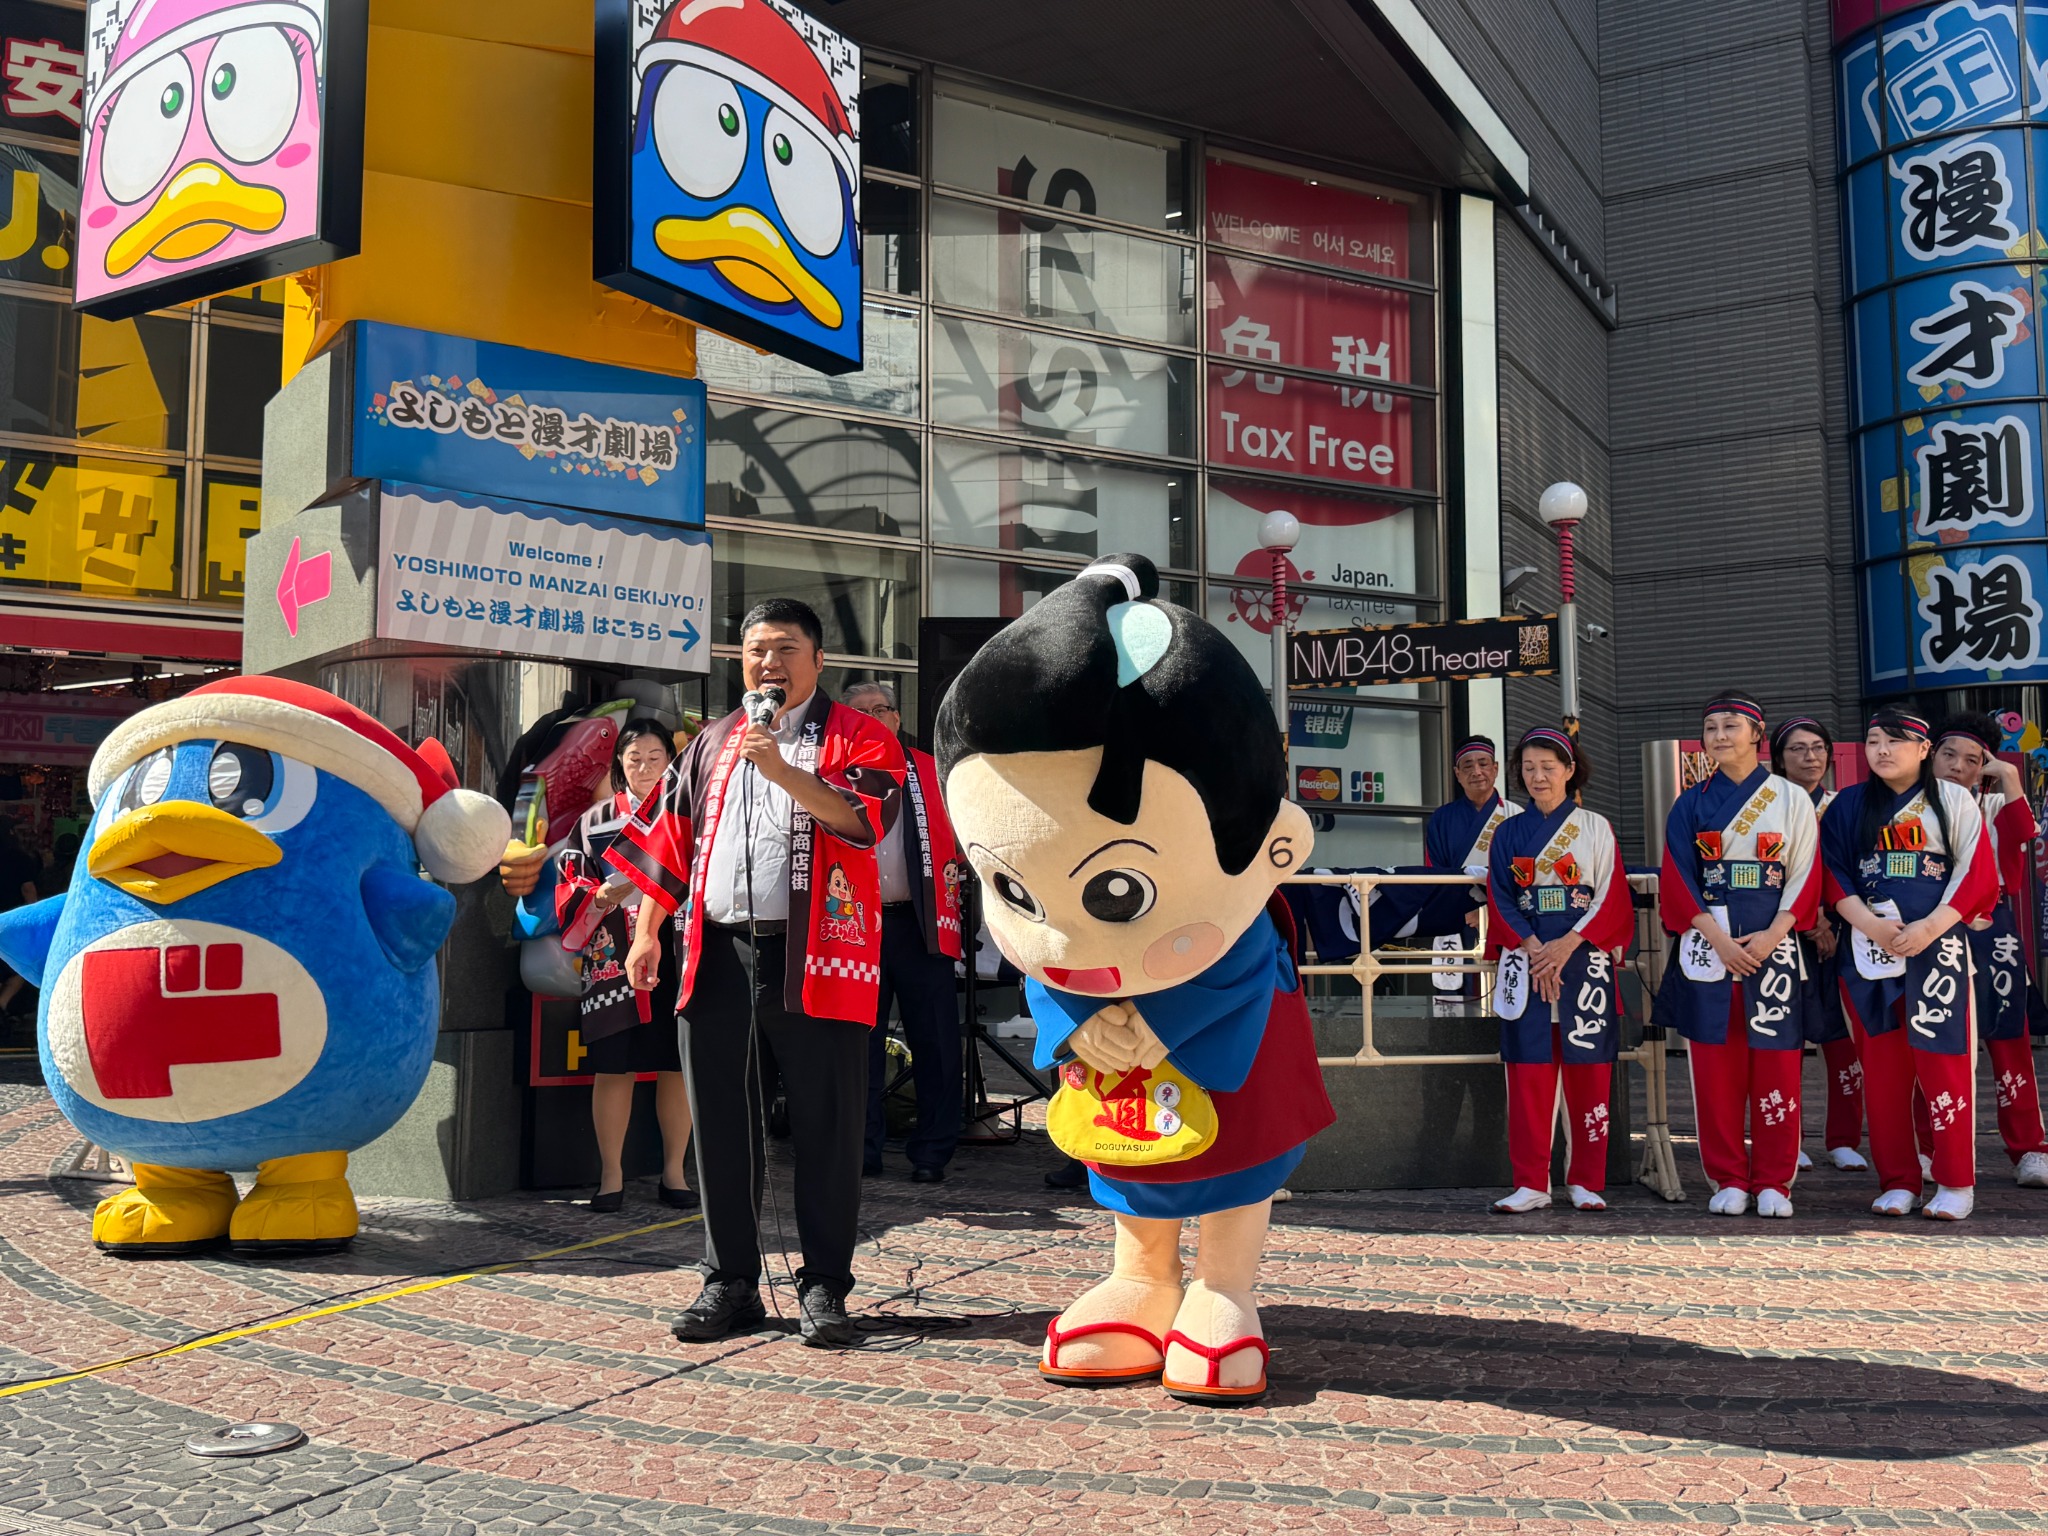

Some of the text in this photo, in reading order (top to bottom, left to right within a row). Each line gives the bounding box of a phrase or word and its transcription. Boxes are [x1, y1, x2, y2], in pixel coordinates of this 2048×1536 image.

[1899, 41, 1995, 132] 5F
[1211, 211, 1300, 245] WELCOME
[1312, 231, 1396, 265] 어서 오세요
[391, 390, 674, 466] よしもと漫才劇場
[1908, 150, 2034, 665] 漫才劇場
[1220, 411, 1395, 475] Tax Free
[392, 553, 705, 612] YOSHIMOTO MANZAI GEKIJYO!
[1331, 563, 1394, 588] Japan.
[395, 589, 663, 641] よしもと漫才劇場 はこちら
[1293, 633, 1513, 680] NMB48 Theater
[1298, 779, 1384, 793] MasterCard JCB
[1567, 951, 1612, 1050] まいど
[1749, 934, 1797, 1037] まいど
[1910, 934, 1964, 1039] まいど
[81, 942, 281, 1100] ド
[1094, 1142, 1154, 1152] DOGUYASUJI
